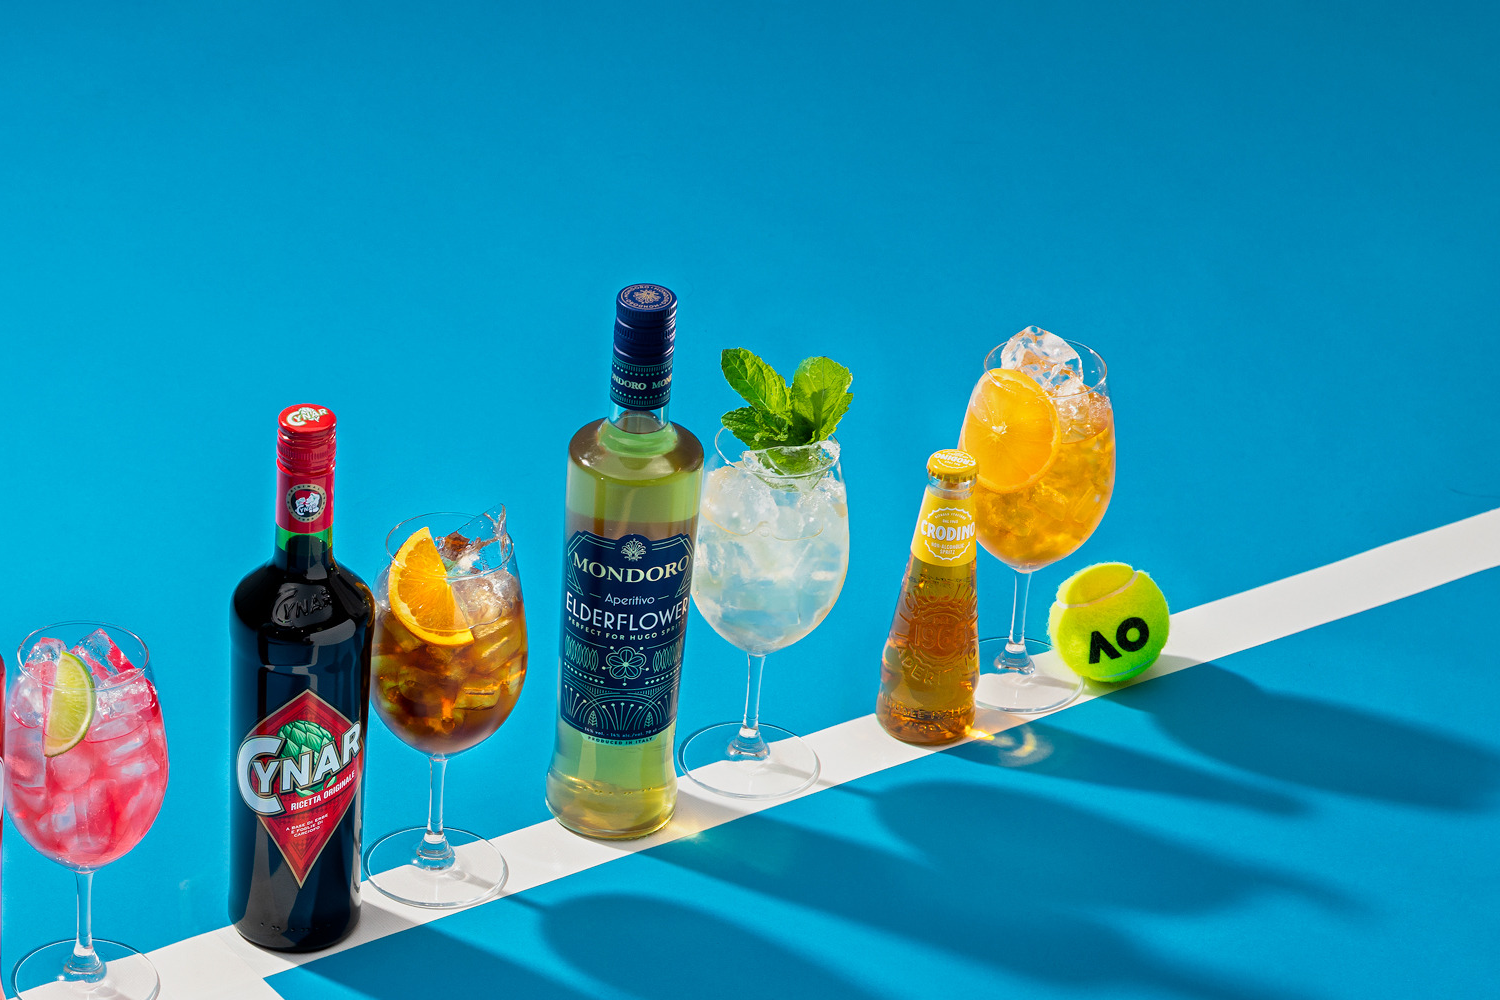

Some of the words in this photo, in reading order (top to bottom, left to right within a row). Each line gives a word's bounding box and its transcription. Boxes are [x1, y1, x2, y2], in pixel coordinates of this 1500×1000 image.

[612, 373, 647, 390] NDORO
[286, 408, 329, 427] CYNAR
[934, 453, 976, 467] CRODINO
[920, 519, 976, 542] CRODINO
[573, 551, 690, 583] MONDORO
[605, 593, 655, 606] Aperitivo
[566, 591, 688, 631] ELDERFLOWER
[568, 616, 602, 637] PERFECT
[606, 632, 625, 640] FOR
[630, 632, 658, 641] HUGO
[588, 736, 623, 745] PRODUCED
[236, 721, 361, 816] CYNAR
[290, 795, 322, 811] RICETTA
[323, 770, 355, 799] ORIGINALE
[293, 826, 321, 838] CARCIOFO
